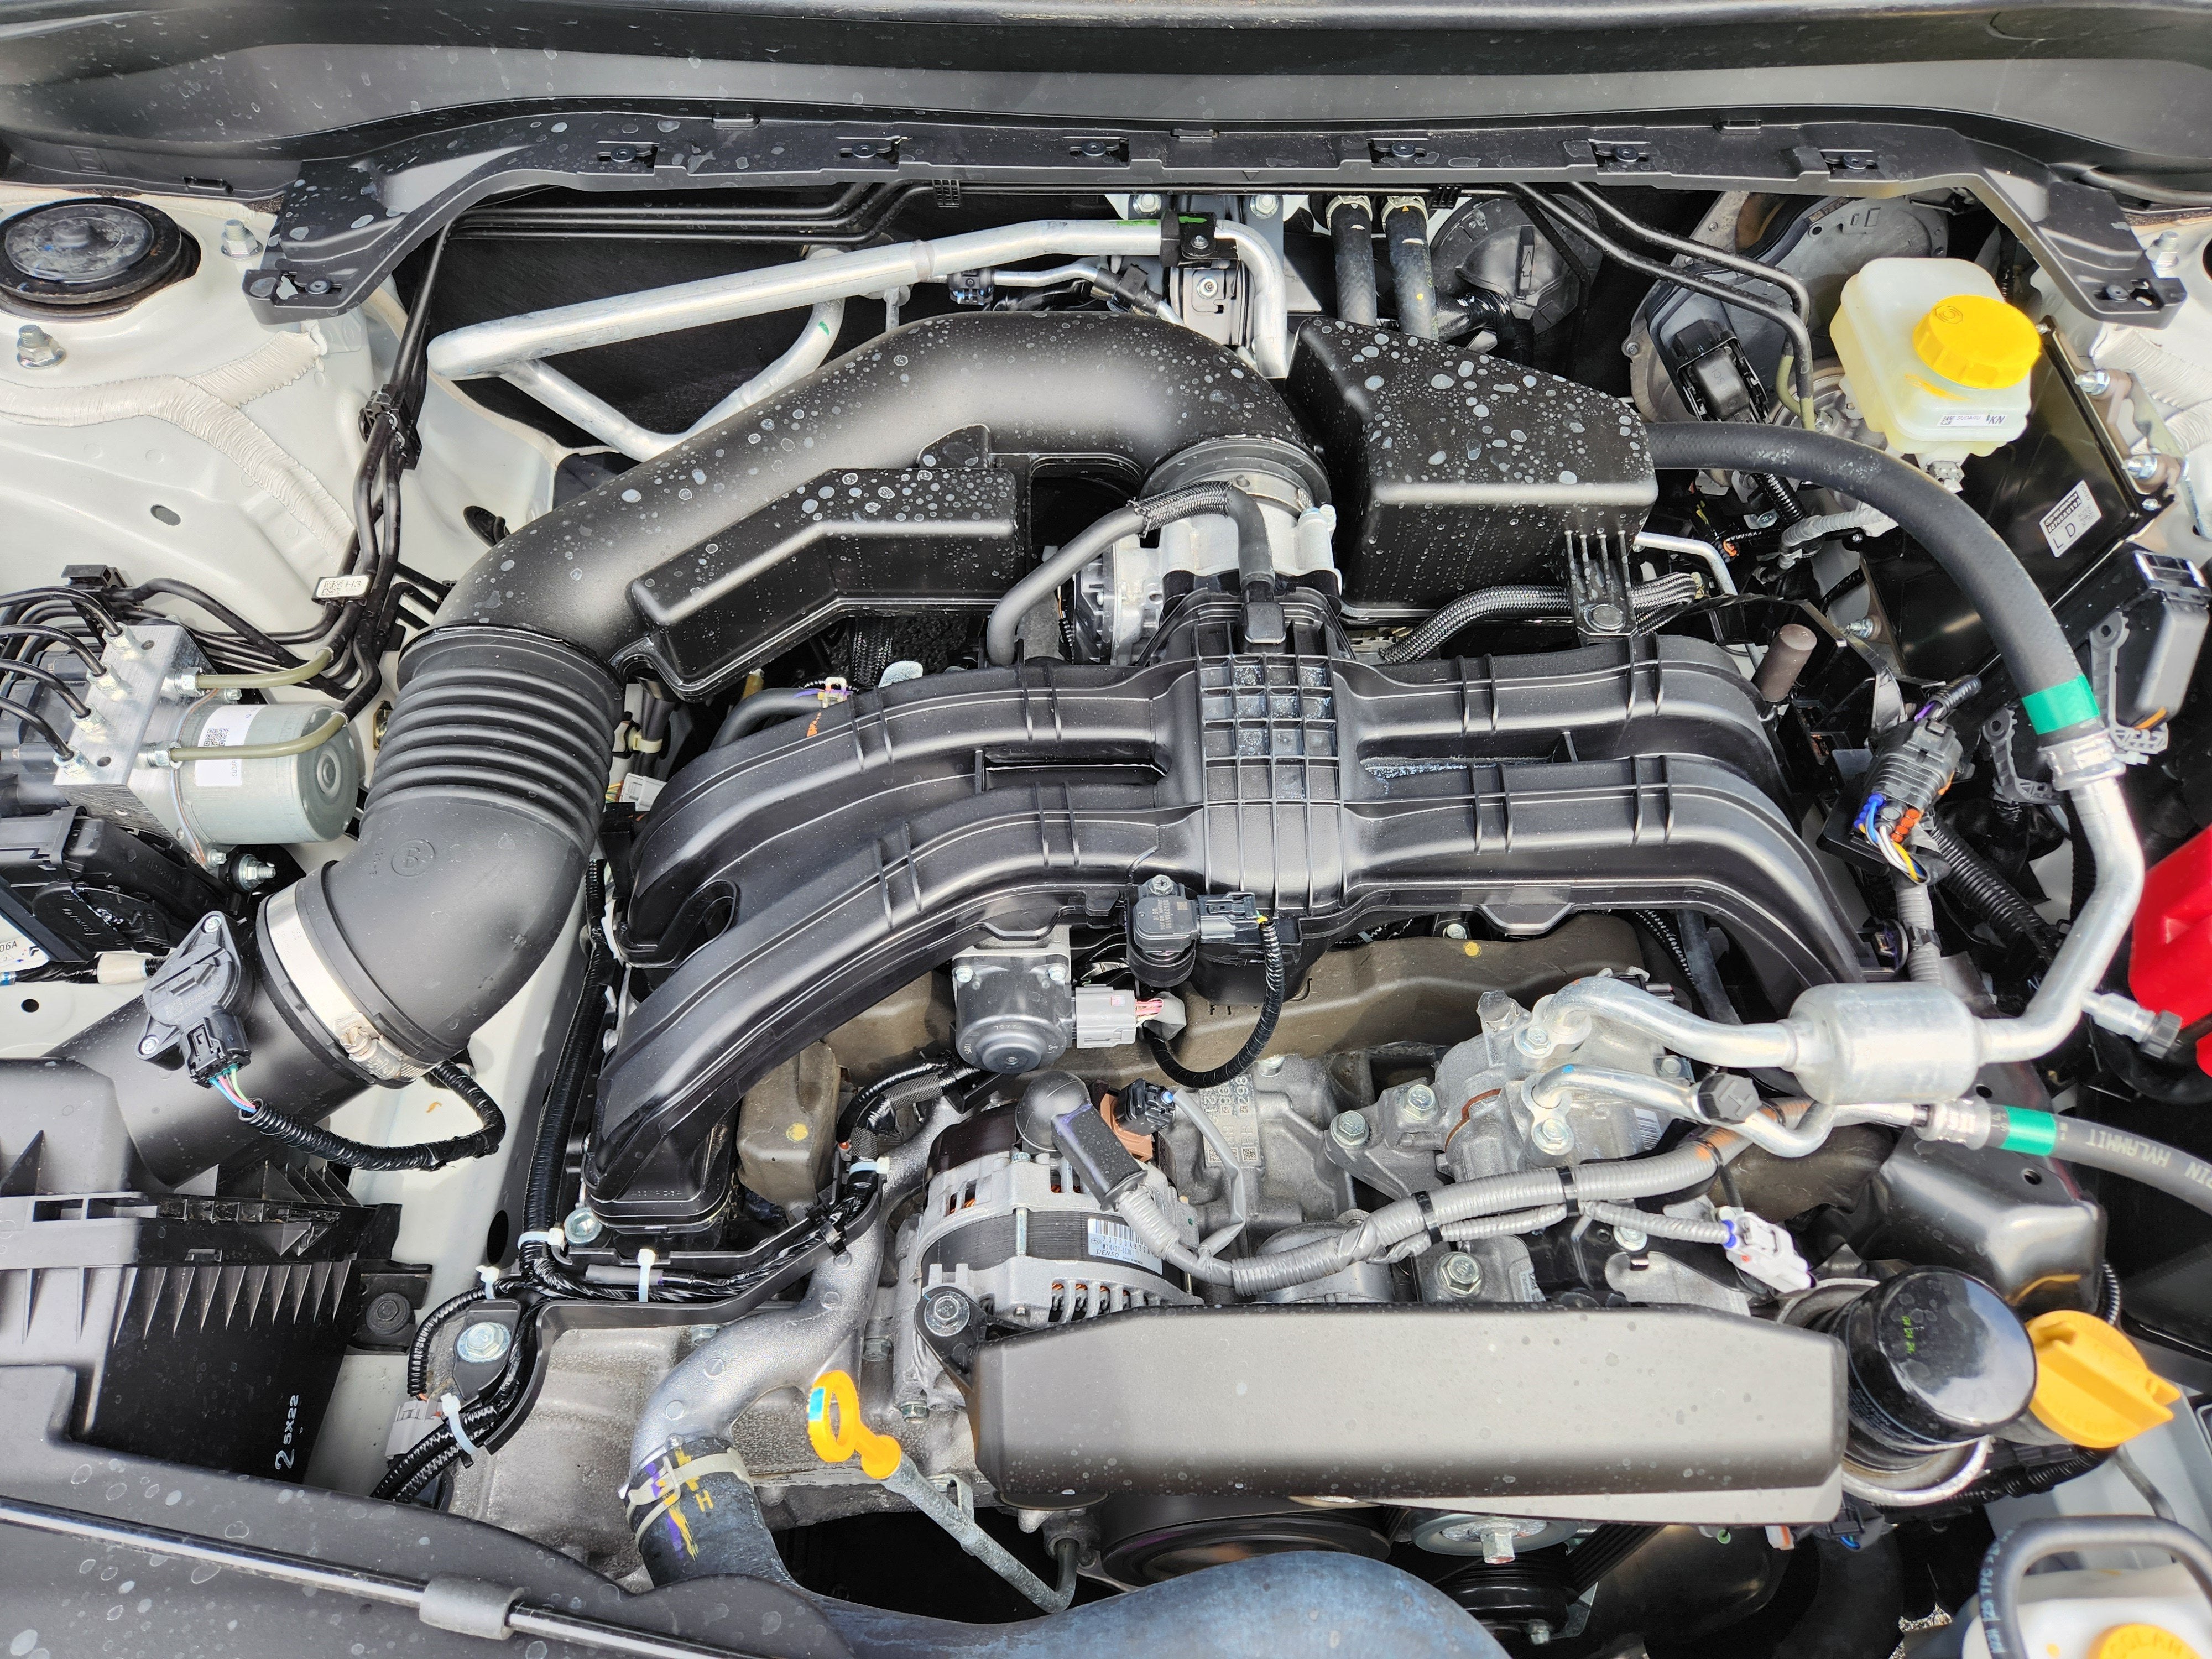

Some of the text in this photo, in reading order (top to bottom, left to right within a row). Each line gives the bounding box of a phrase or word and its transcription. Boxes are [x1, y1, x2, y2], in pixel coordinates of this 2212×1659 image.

[2053, 538, 2064, 549] L
[2065, 523, 2076, 539] D
[1235, 1076, 1249, 1104] 298
[1096, 1249, 1120, 1259] DENSO
[274, 1394, 300, 1470] 2 5X22
